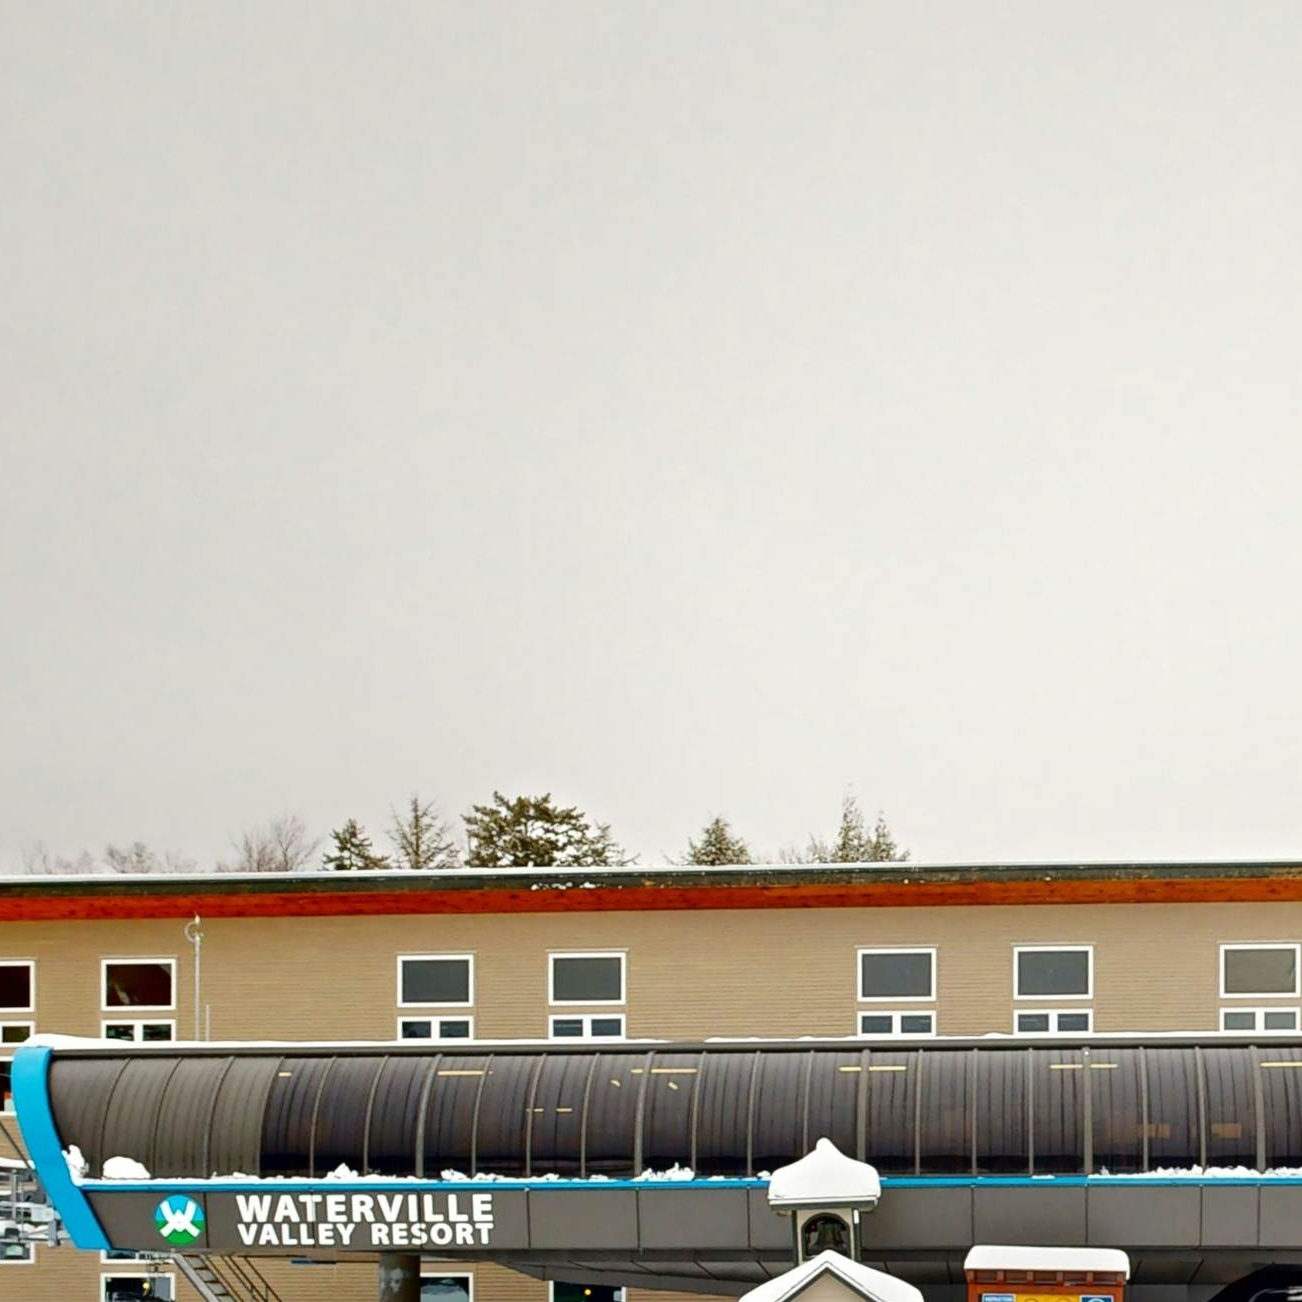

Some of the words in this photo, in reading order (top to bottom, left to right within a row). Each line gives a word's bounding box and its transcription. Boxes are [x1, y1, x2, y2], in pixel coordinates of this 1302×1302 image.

[236, 1194, 494, 1222] WATERVILLE
[237, 1222, 355, 1245] VALLEY
[371, 1222, 494, 1245] RESORT
